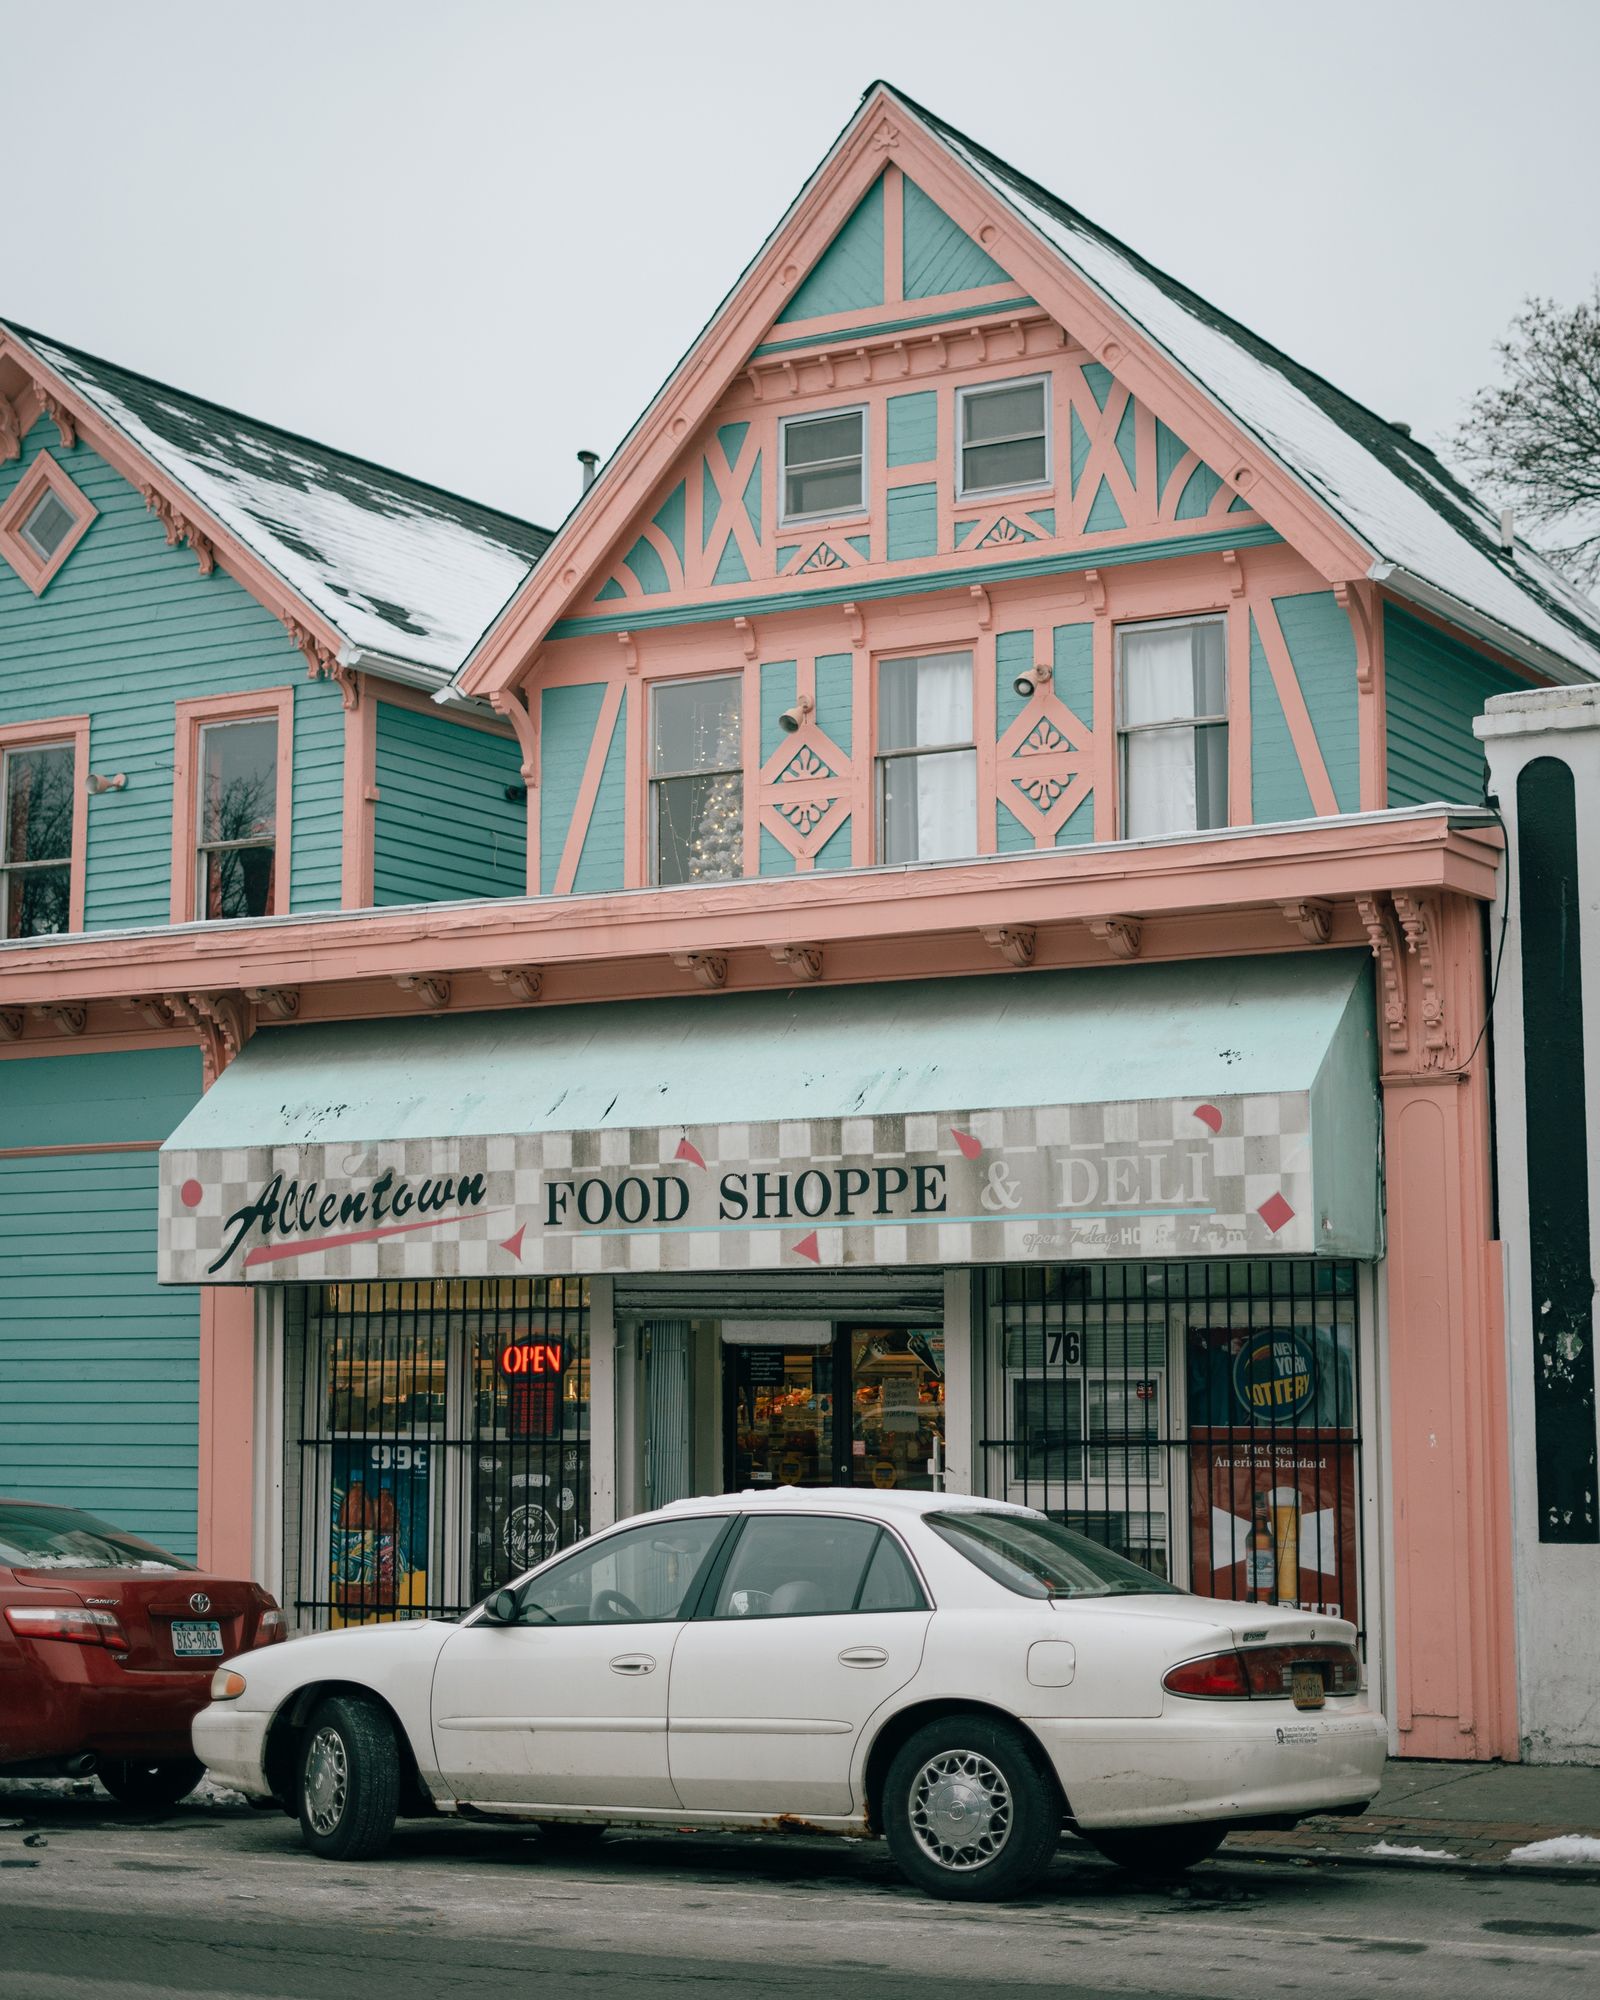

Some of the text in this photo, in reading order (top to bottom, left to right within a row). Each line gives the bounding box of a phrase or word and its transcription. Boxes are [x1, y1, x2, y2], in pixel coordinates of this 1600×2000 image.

[543, 1151, 1211, 1225] FOOD SHOPPE & DELI
[208, 1172, 487, 1274] Allentown
[1082, 1224, 1119, 1253] days
[503, 1345, 561, 1373] OPEN
[1047, 1331, 1080, 1365] 76
[1275, 1356, 1308, 1376] YORK
[371, 1445, 427, 1470] 99¢
[1266, 1443, 1298, 1455] Grea
